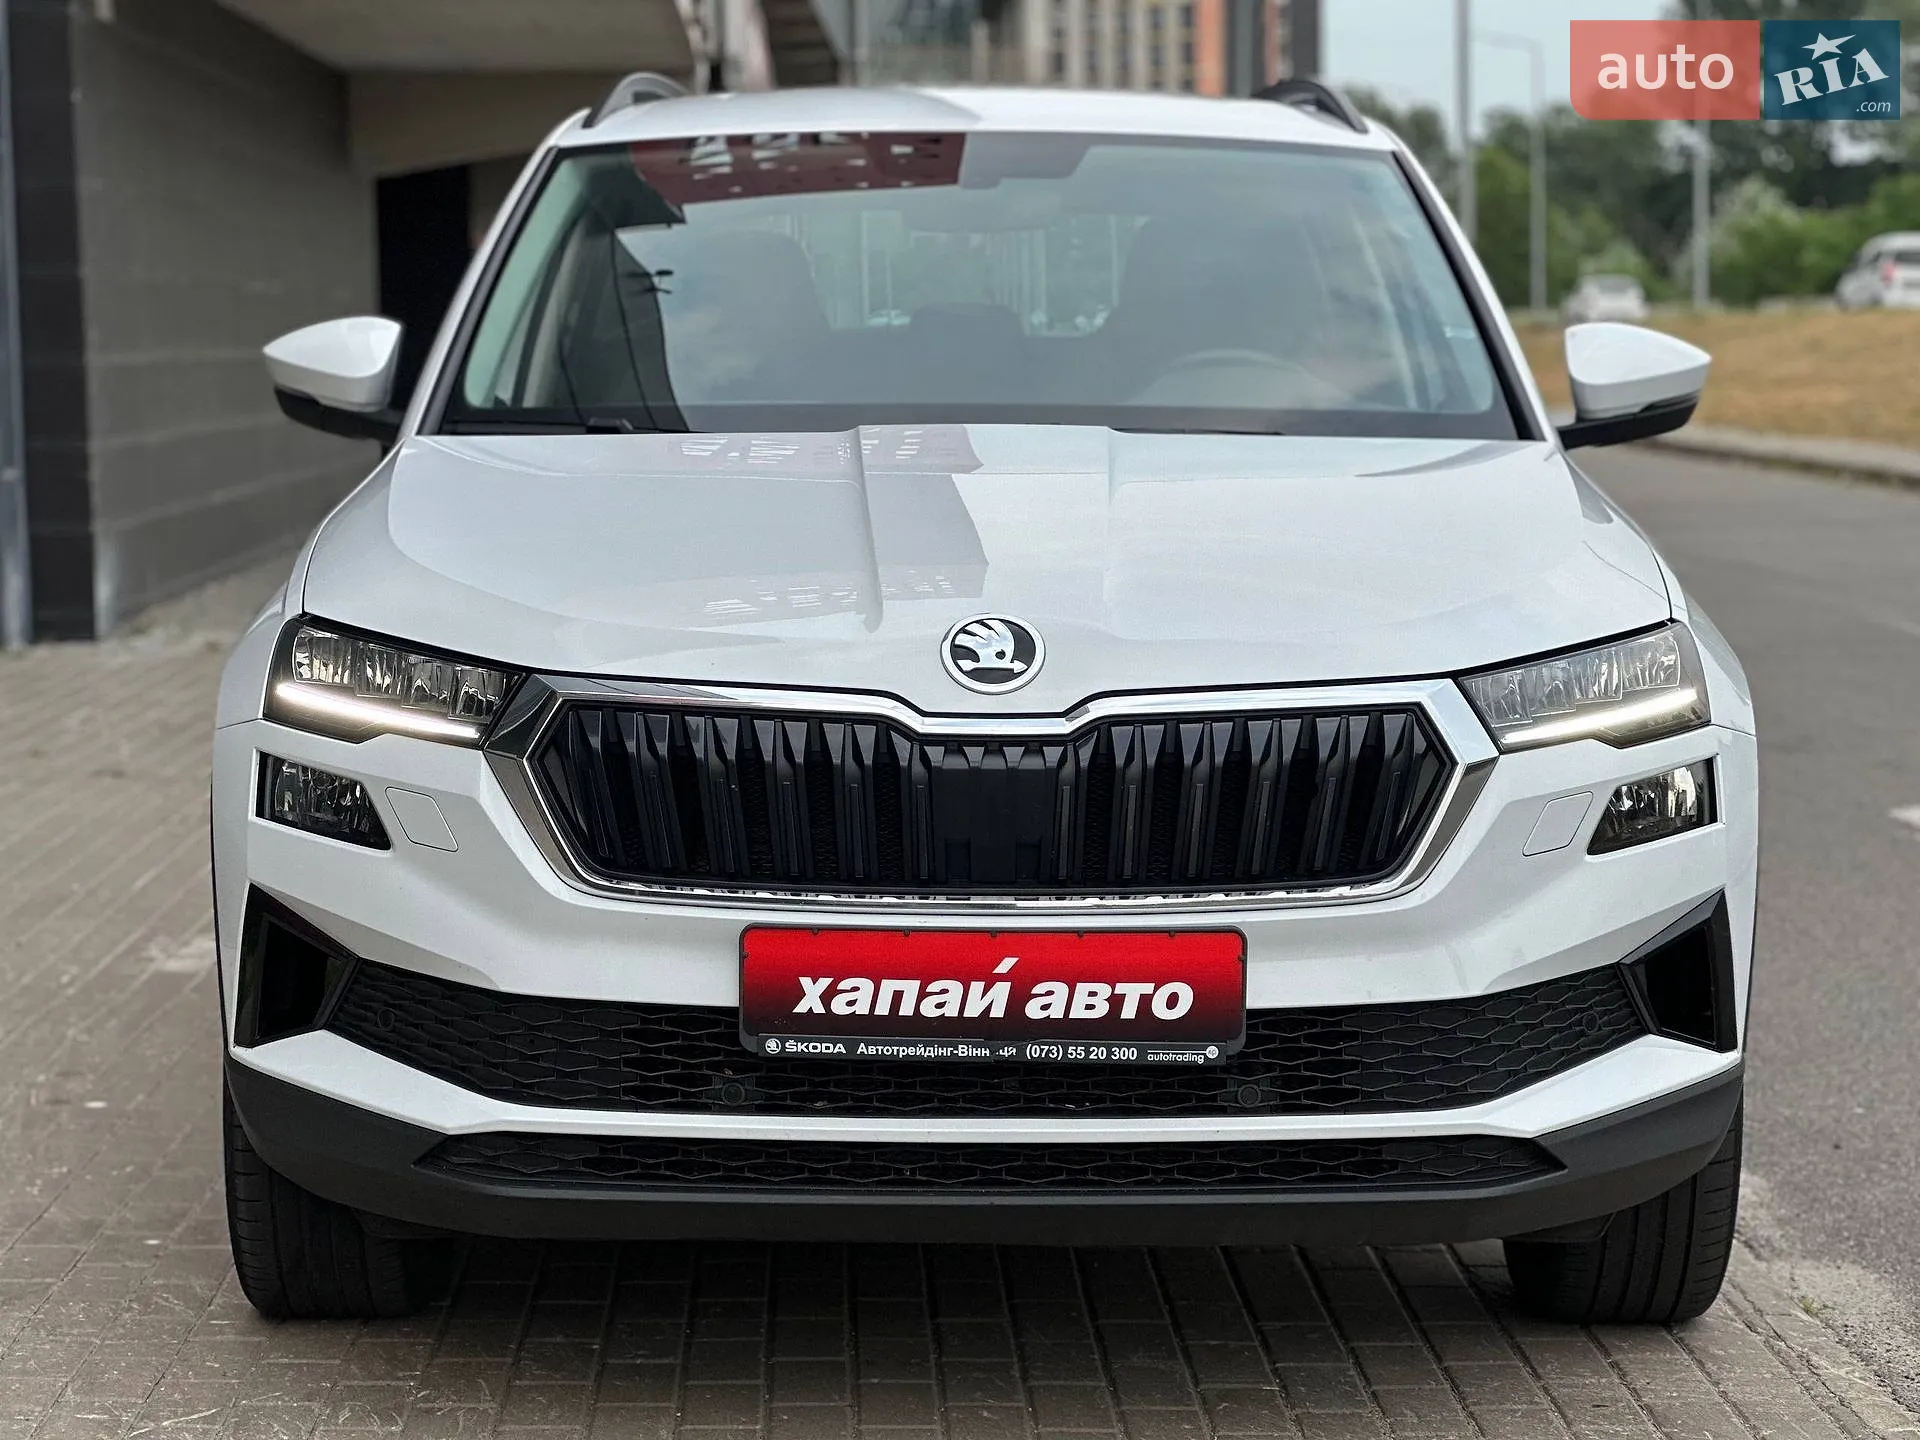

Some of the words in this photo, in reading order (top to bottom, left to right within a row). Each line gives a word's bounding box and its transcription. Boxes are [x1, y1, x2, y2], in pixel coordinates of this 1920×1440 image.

[1024, 980, 1195, 1021] авто
[785, 1040, 847, 1054] ŠKODA
[856, 1042, 1017, 1058] Автотрейдінг-Віннця
[1026, 1043, 1063, 1061] (073)
[1067, 1046, 1085, 1060] 55
[1089, 1046, 1107, 1060] 20
[1111, 1047, 1138, 1061] 300
[1147, 1052, 1205, 1064] autotrading
